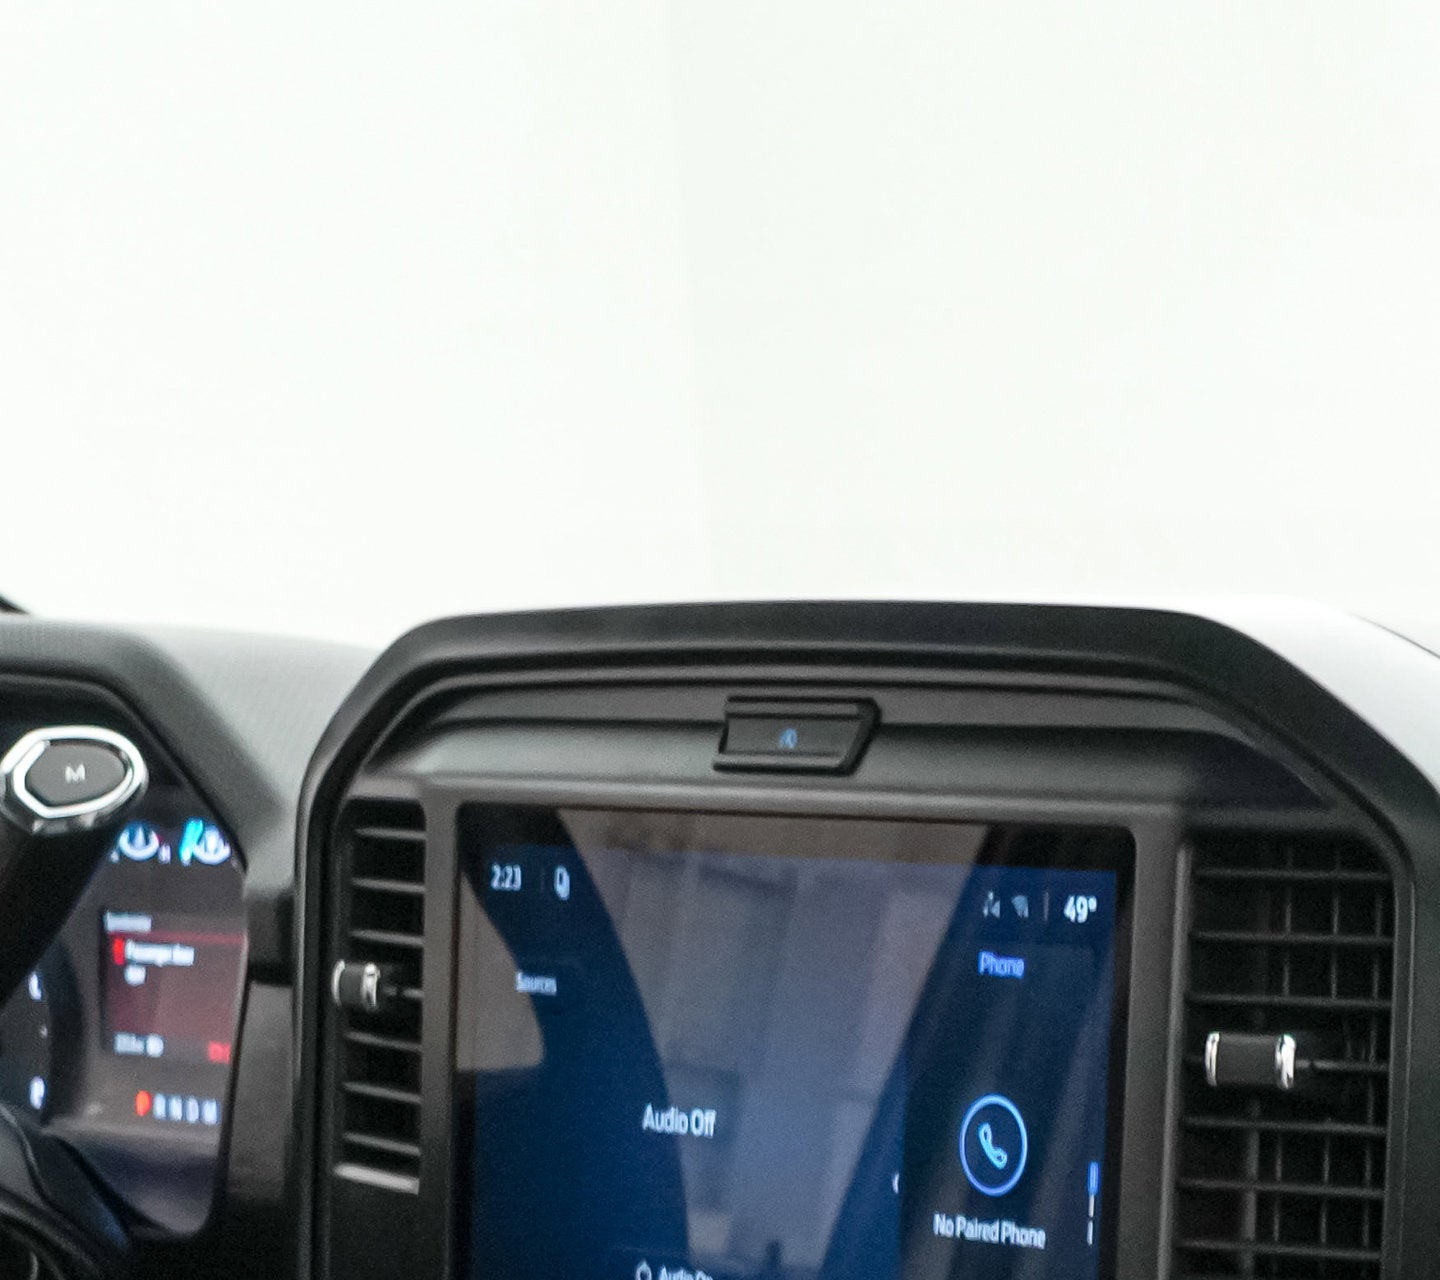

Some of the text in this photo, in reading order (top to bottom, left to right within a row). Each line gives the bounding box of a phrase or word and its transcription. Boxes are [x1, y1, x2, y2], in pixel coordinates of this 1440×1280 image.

[65, 763, 86, 784] M
[978, 951, 1025, 978] Phone
[643, 1103, 717, 1139] Audio Off
[933, 1213, 1046, 1249] No Paired Phone
